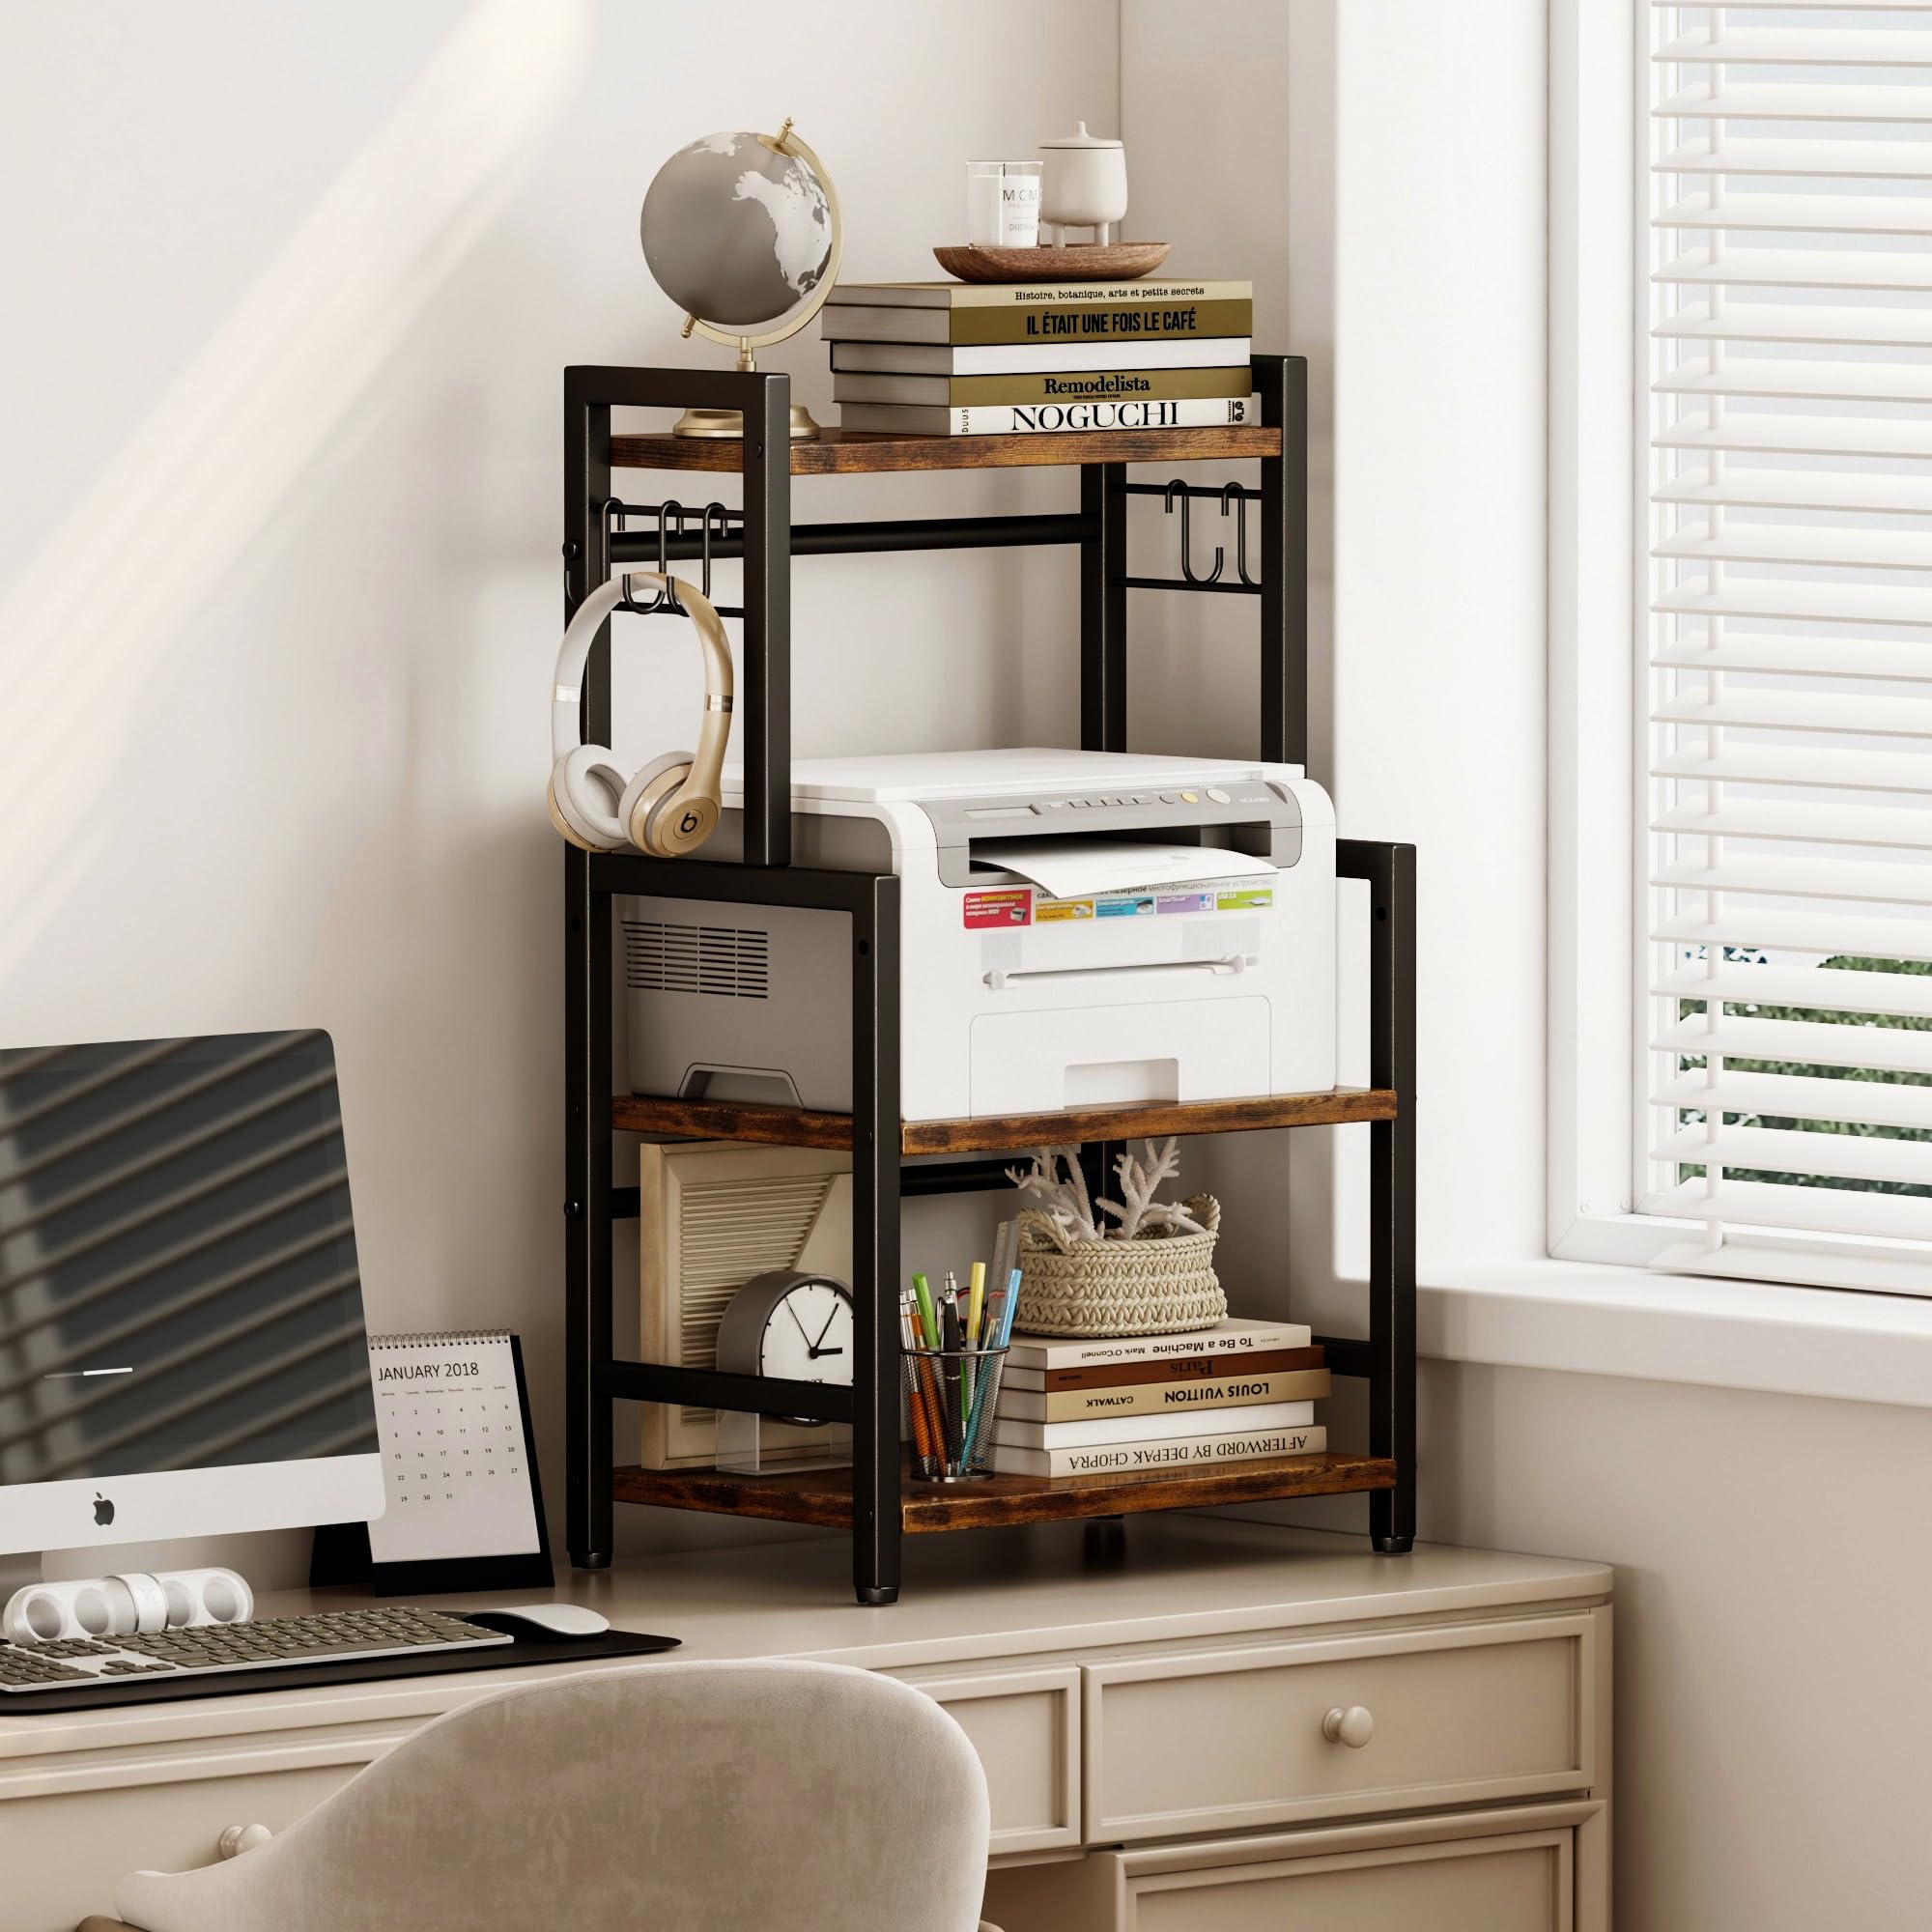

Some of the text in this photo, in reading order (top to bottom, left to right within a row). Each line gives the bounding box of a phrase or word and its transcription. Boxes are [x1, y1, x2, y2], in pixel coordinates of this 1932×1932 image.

[1015, 292, 1056, 300] Histoire,
[1058, 290, 1106, 299] botanique,
[1108, 289, 1128, 298] arts
[1142, 288, 1168, 298] petits
[1171, 287, 1205, 296] secrets
[1027, 306, 1197, 335] IL ÉTAIT UNE FOIS LE CAFÉ
[1043, 375, 1151, 394] Remodelista
[1011, 402, 1179, 431] NOGUCHI
[1152, 1342, 1205, 1354] Machine
[1219, 1339, 1236, 1349] Be
[1240, 1337, 1254, 1348] To
[1081, 1350, 1122, 1359] O'Connell
[378, 1362, 479, 1380] JANUARY 2018
[1171, 1359, 1213, 1377] Paris
[1086, 1382, 1269, 1407] LOUIS VUITTON CATWALK
[1069, 1435, 1308, 1469] AFTERWORD BY DEEPAK CHOPRA
